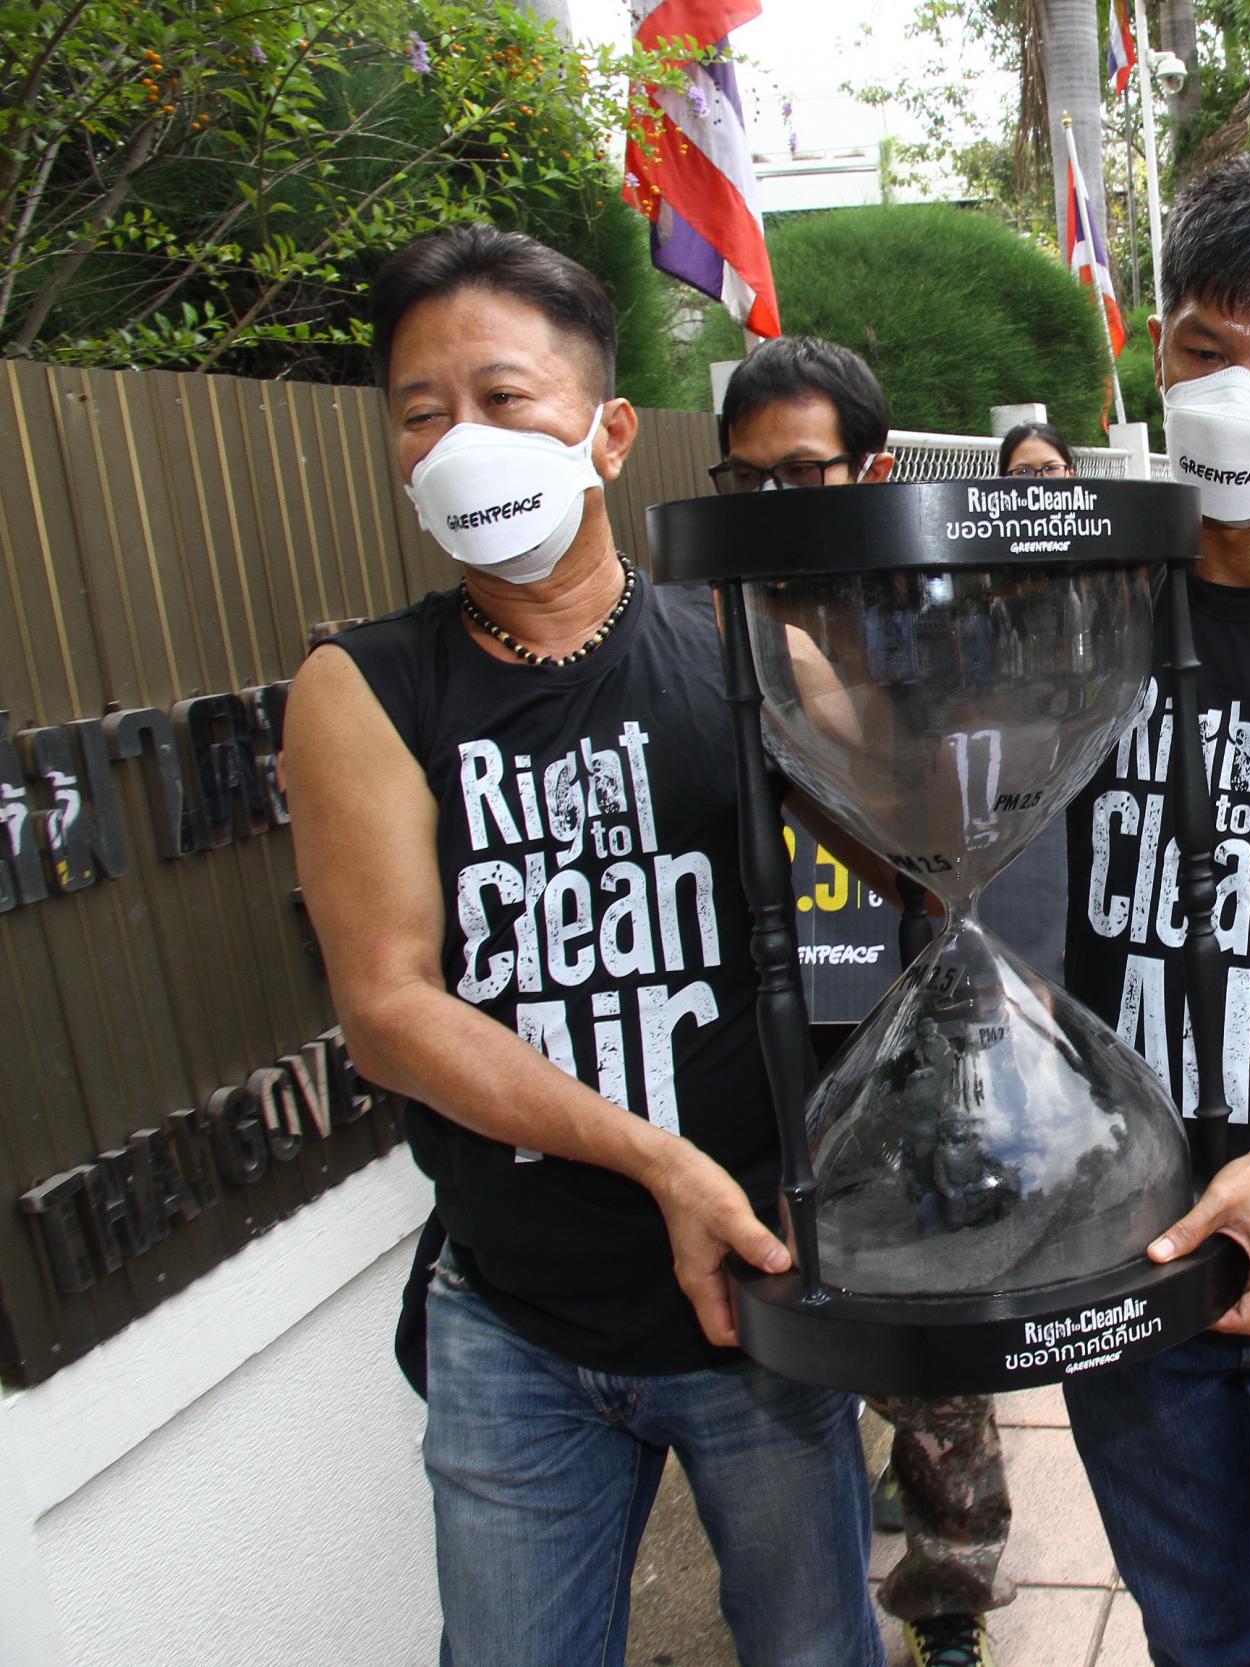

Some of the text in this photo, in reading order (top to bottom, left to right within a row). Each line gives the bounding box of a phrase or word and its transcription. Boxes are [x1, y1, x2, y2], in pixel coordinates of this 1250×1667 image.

[447, 493, 543, 531] GREENPEACE
[967, 486, 1019, 518] Right
[946, 513, 1112, 540] ขออากาศดีคืนมา
[1010, 541, 1071, 554] GREENPEACE
[458, 721, 658, 869] Right
[994, 791, 1043, 812] PM 2.5
[591, 820, 632, 859] to
[783, 825, 849, 912] .5
[457, 851, 721, 1004] Clean
[797, 944, 885, 965] ENPEACE
[1005, 1317, 1162, 1370] ขออากาศดีคืนมา
[1025, 1317, 1073, 1347] Right
[1065, 1350, 1122, 1374] GREENPEACE
